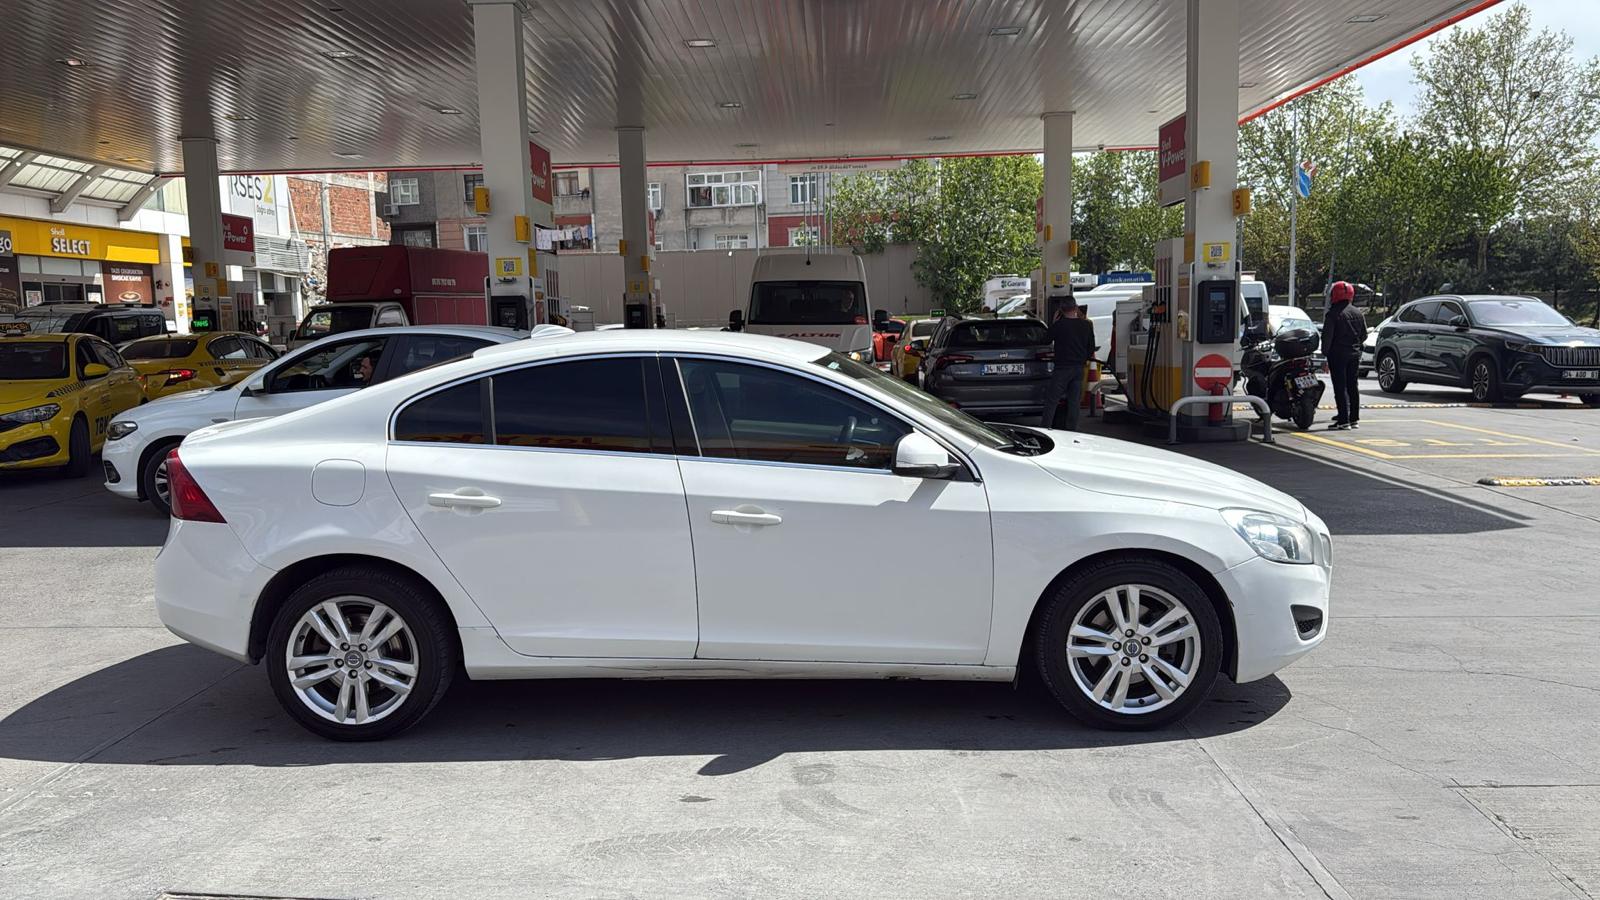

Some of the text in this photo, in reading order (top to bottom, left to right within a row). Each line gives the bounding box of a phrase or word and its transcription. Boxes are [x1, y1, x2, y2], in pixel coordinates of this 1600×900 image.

[1161, 137, 1171, 151] Shell
[1193, 168, 1199, 184] 6
[1235, 195, 1241, 210] 5
[50, 228, 65, 236] Shell
[52, 238, 91, 255] SELECT
